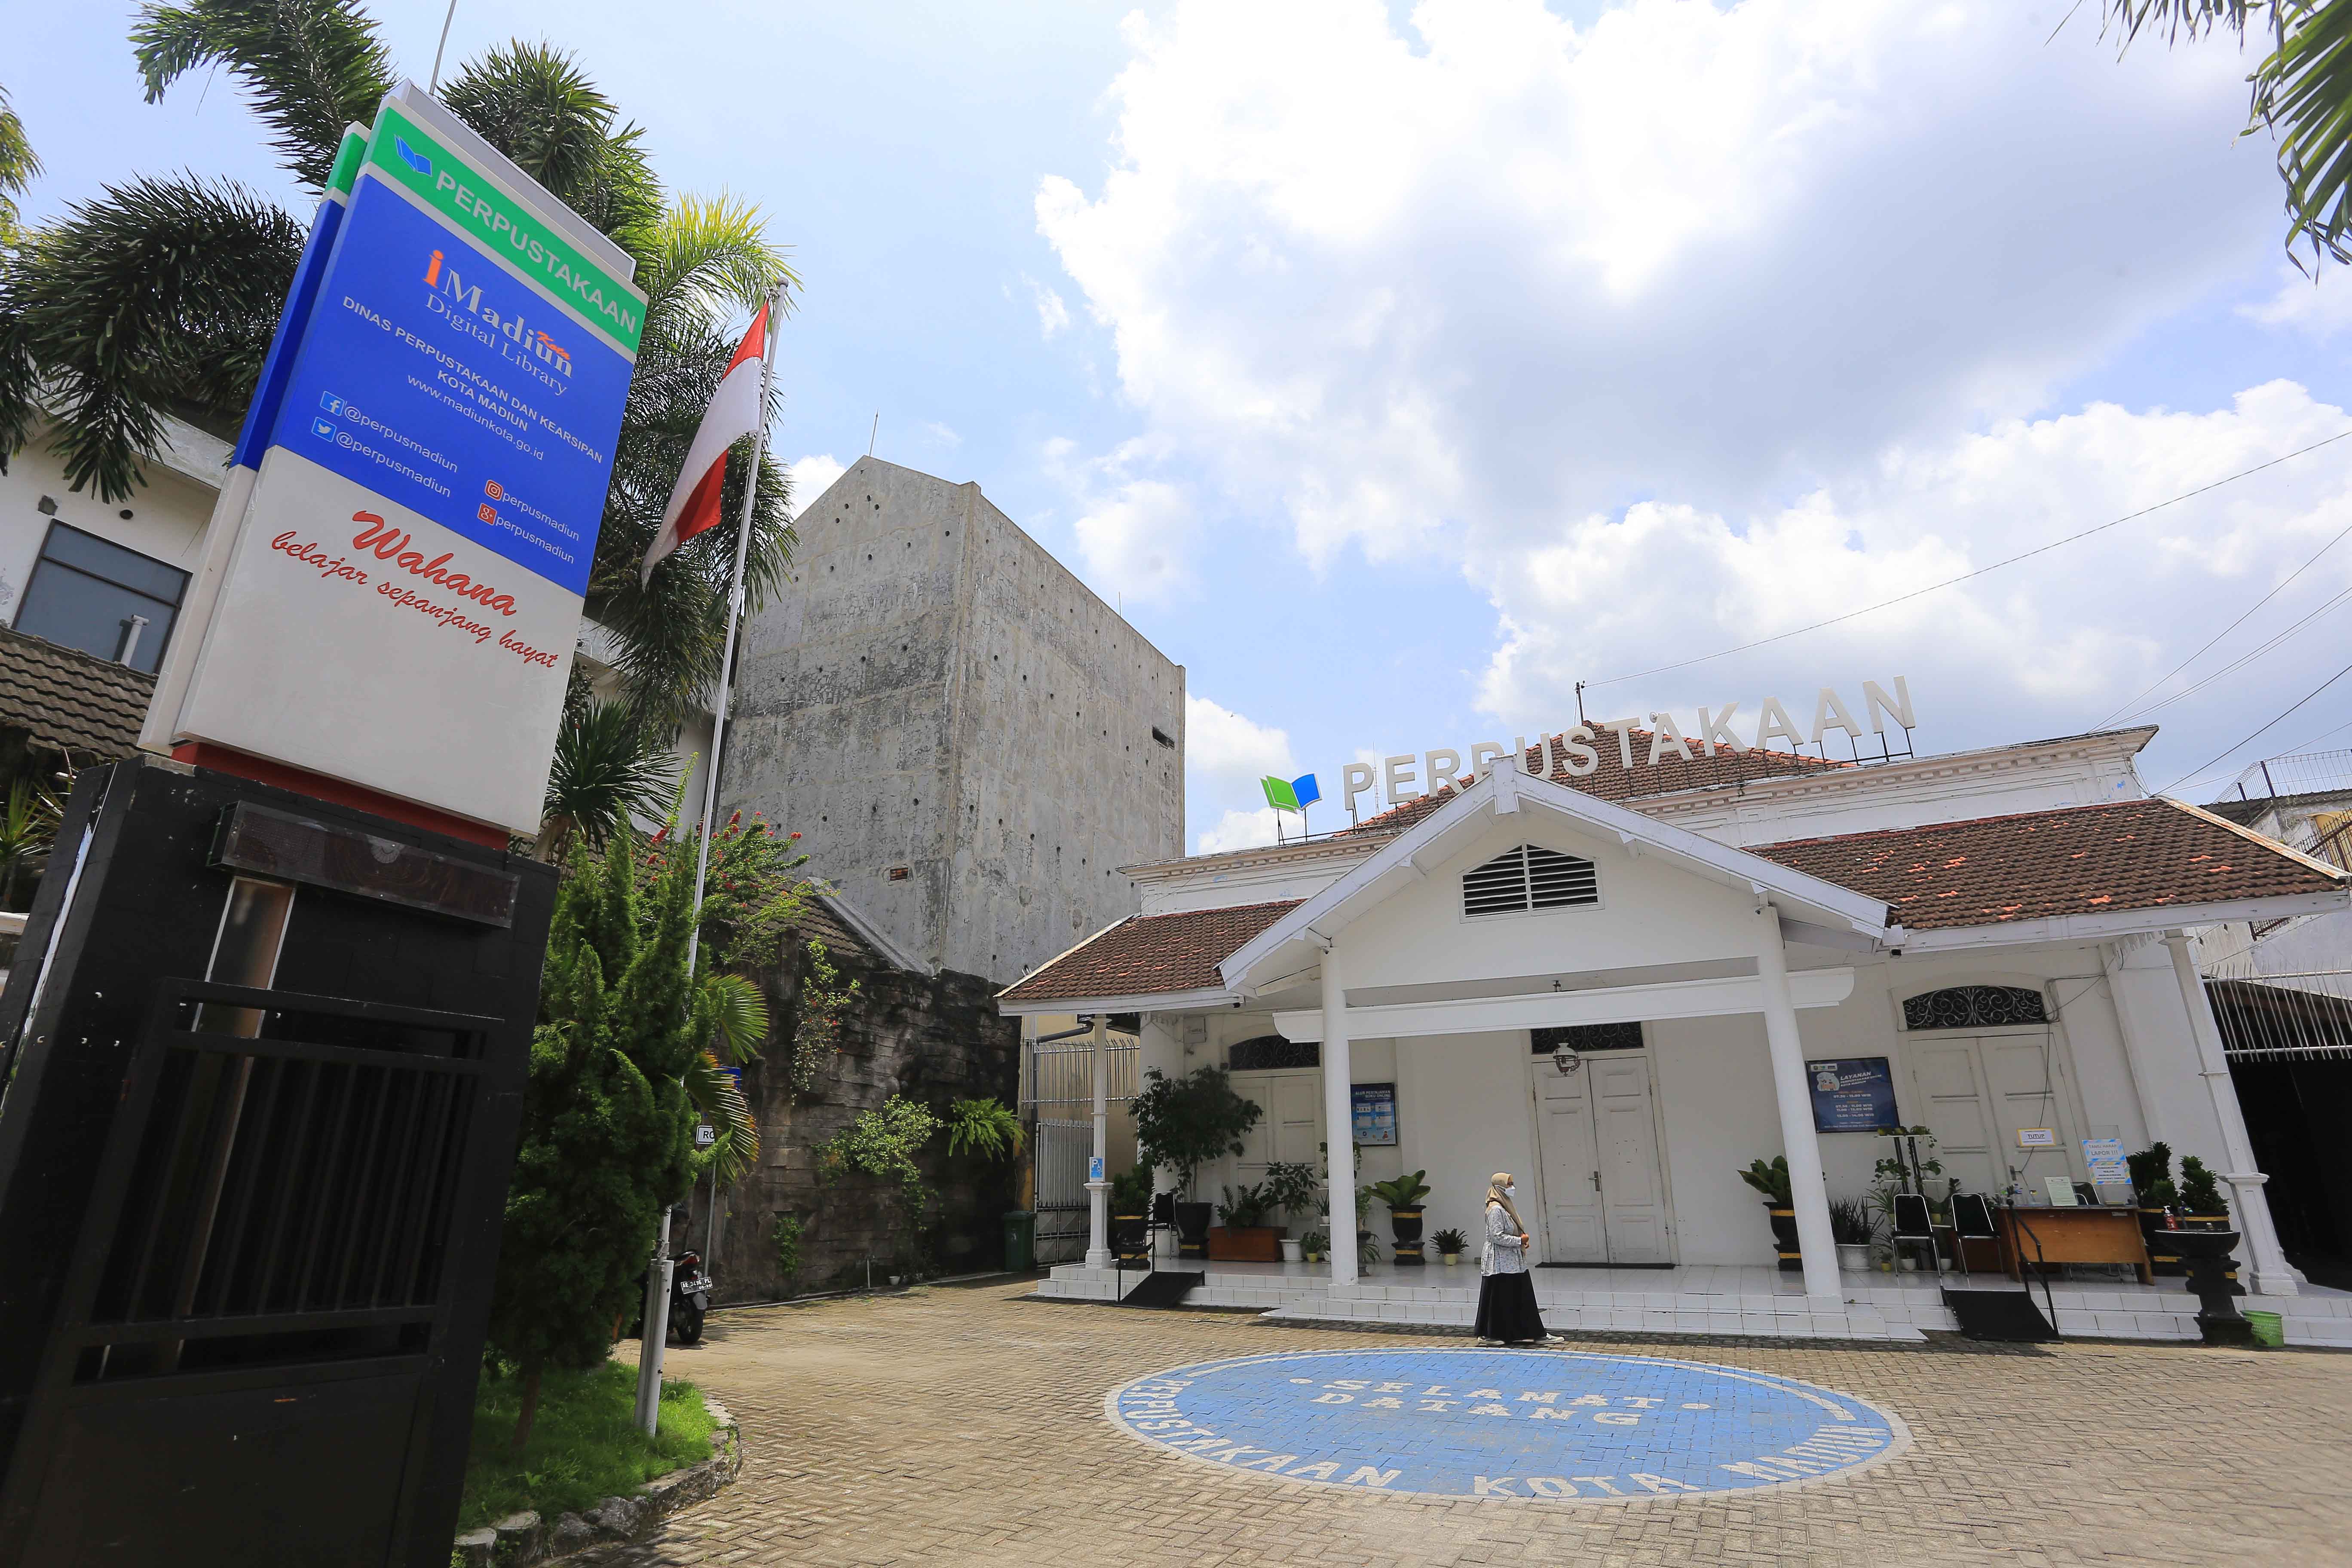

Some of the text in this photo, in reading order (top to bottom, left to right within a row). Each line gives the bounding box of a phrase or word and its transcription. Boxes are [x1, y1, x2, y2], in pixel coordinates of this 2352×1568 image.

[436, 170, 636, 334] PERPUSTAKAAN
[425, 293, 567, 397] Digital Library
[343, 296, 602, 464] DINAS PERPUSTAKAAN DAN KEARSIPAN
[436, 370, 529, 432] KOTA MADIUN
[345, 406, 459, 473] @perpusmadiun
[408, 375, 544, 461] www.madiunkota.go.id
[336, 432, 451, 498] @perpusmadiun
[495, 515, 574, 564] perpusmadiun
[502, 492, 580, 541] perpusmadiun
[352, 510, 517, 616] Wahana
[271, 531, 558, 668] belajar sepanjang hayat
[1343, 676, 1915, 810] PERPUSTAKAAN
[1841, 1072, 1871, 1080] LAYANAN
[1092, 1159, 1098, 1167] P
[1310, 1393, 1641, 1425] DATANG
[1323, 1379, 1663, 1409] SELAMAT
[1122, 1378, 1890, 1496] PERPUSTAKAAN KOTA MADIUN
